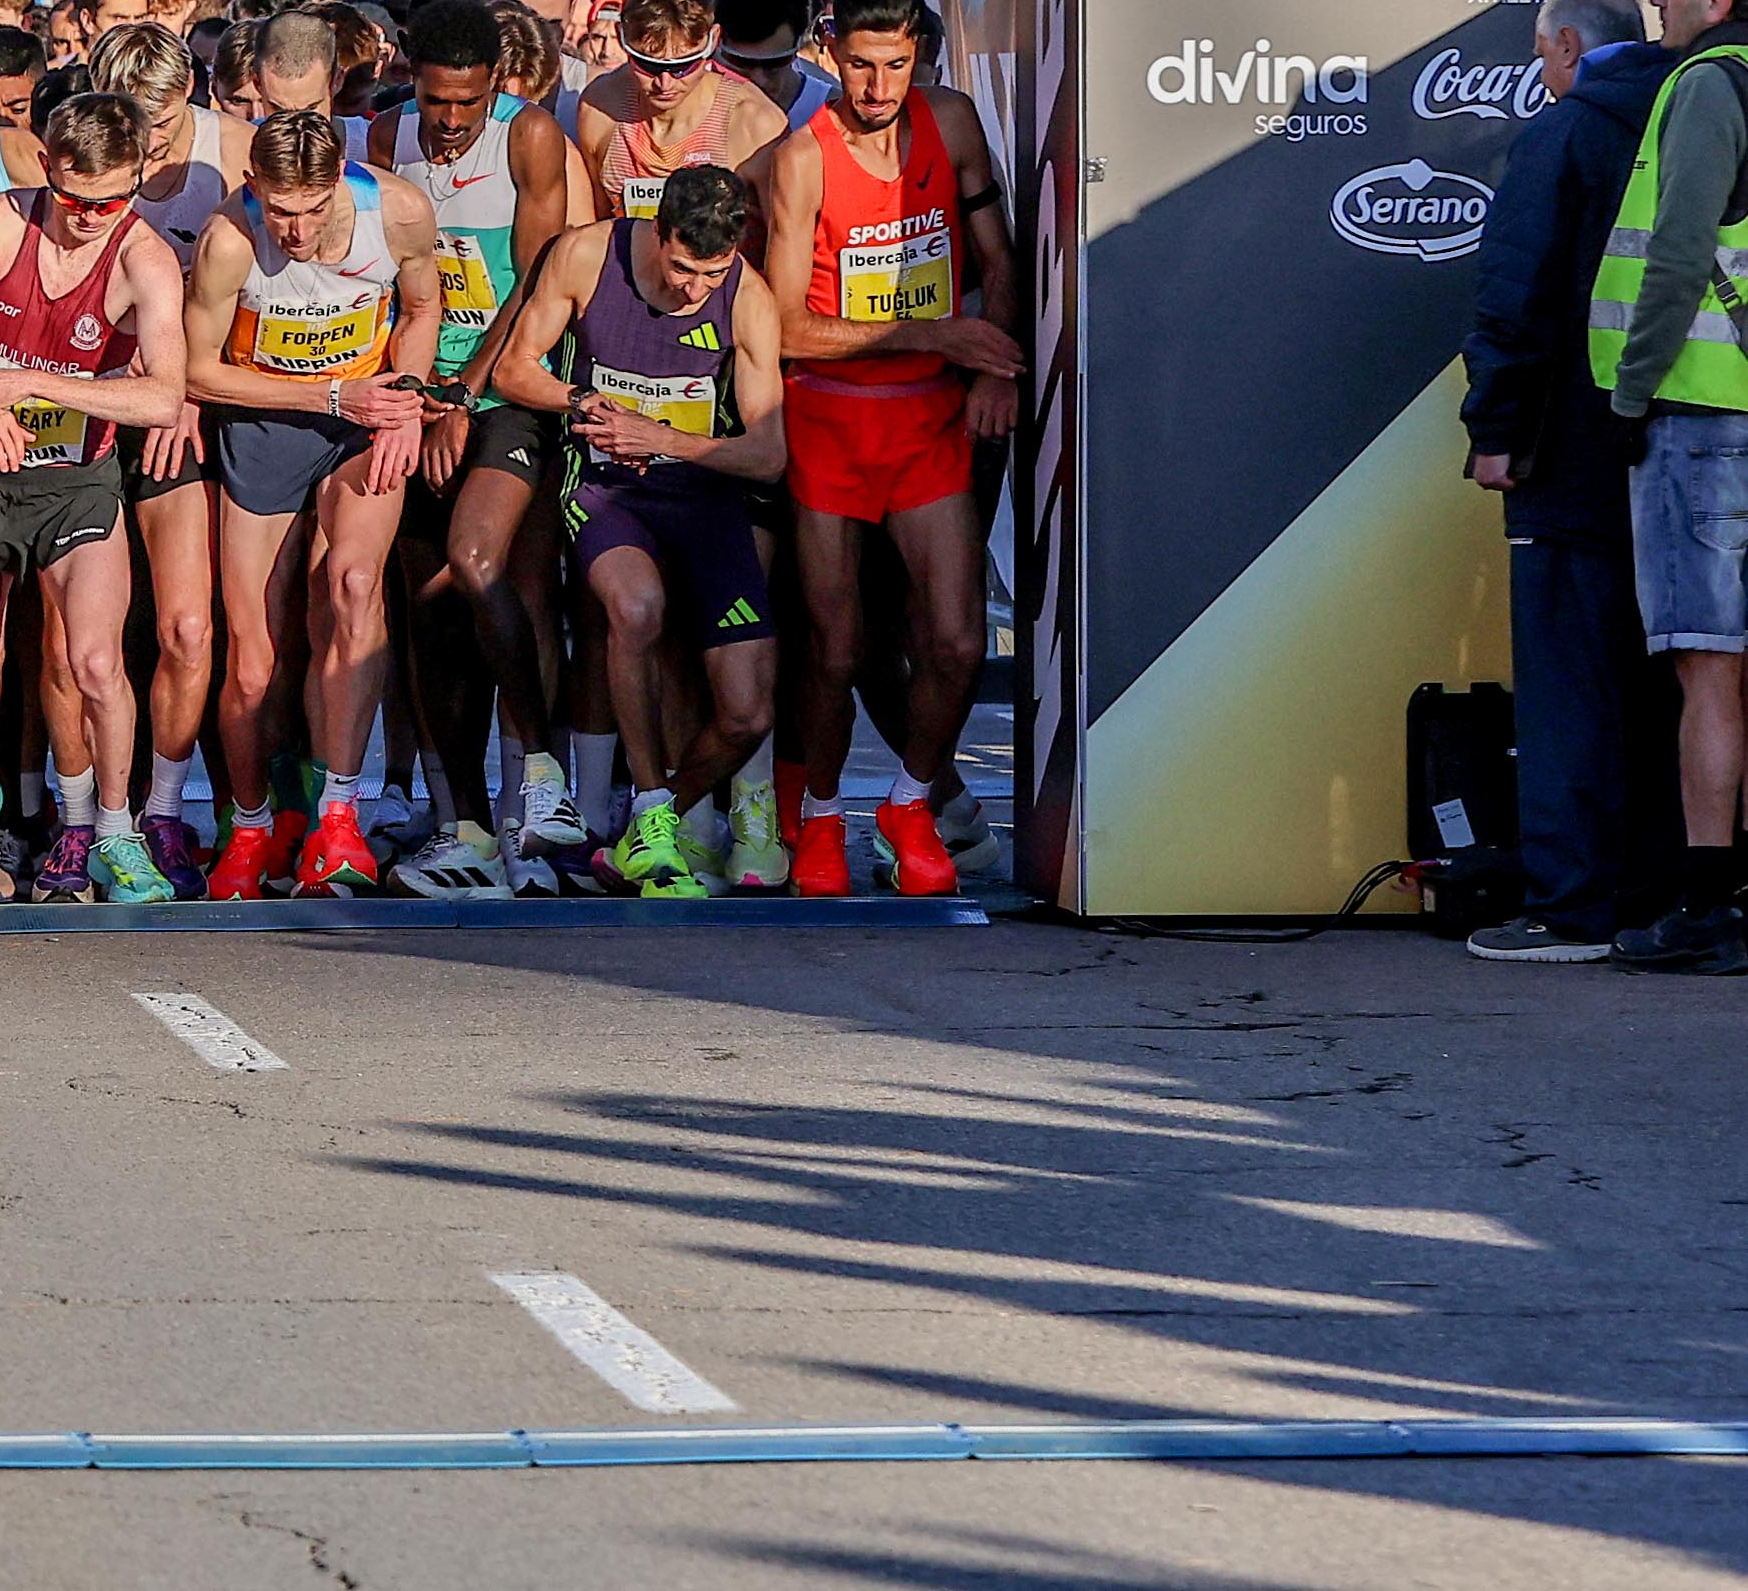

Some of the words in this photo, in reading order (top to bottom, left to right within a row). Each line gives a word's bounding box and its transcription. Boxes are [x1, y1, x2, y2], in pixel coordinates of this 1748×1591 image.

[1146, 38, 1369, 105] divina
[1412, 47, 1556, 120] Coca-C
[1253, 113, 1368, 142] seguros
[630, 184, 662, 200] Iber
[1353, 186, 1488, 226] Serrano
[847, 208, 945, 245] SPORTIVE
[849, 246, 919, 267] Ibercaja
[268, 303, 341, 317] Ibercaja
[282, 323, 355, 345] FOPPEN
[270, 349, 360, 370] KIPRUN
[309, 346, 327, 356] 30
[601, 373, 672, 398] Ibercaja
[11, 410, 65, 431] EARY
